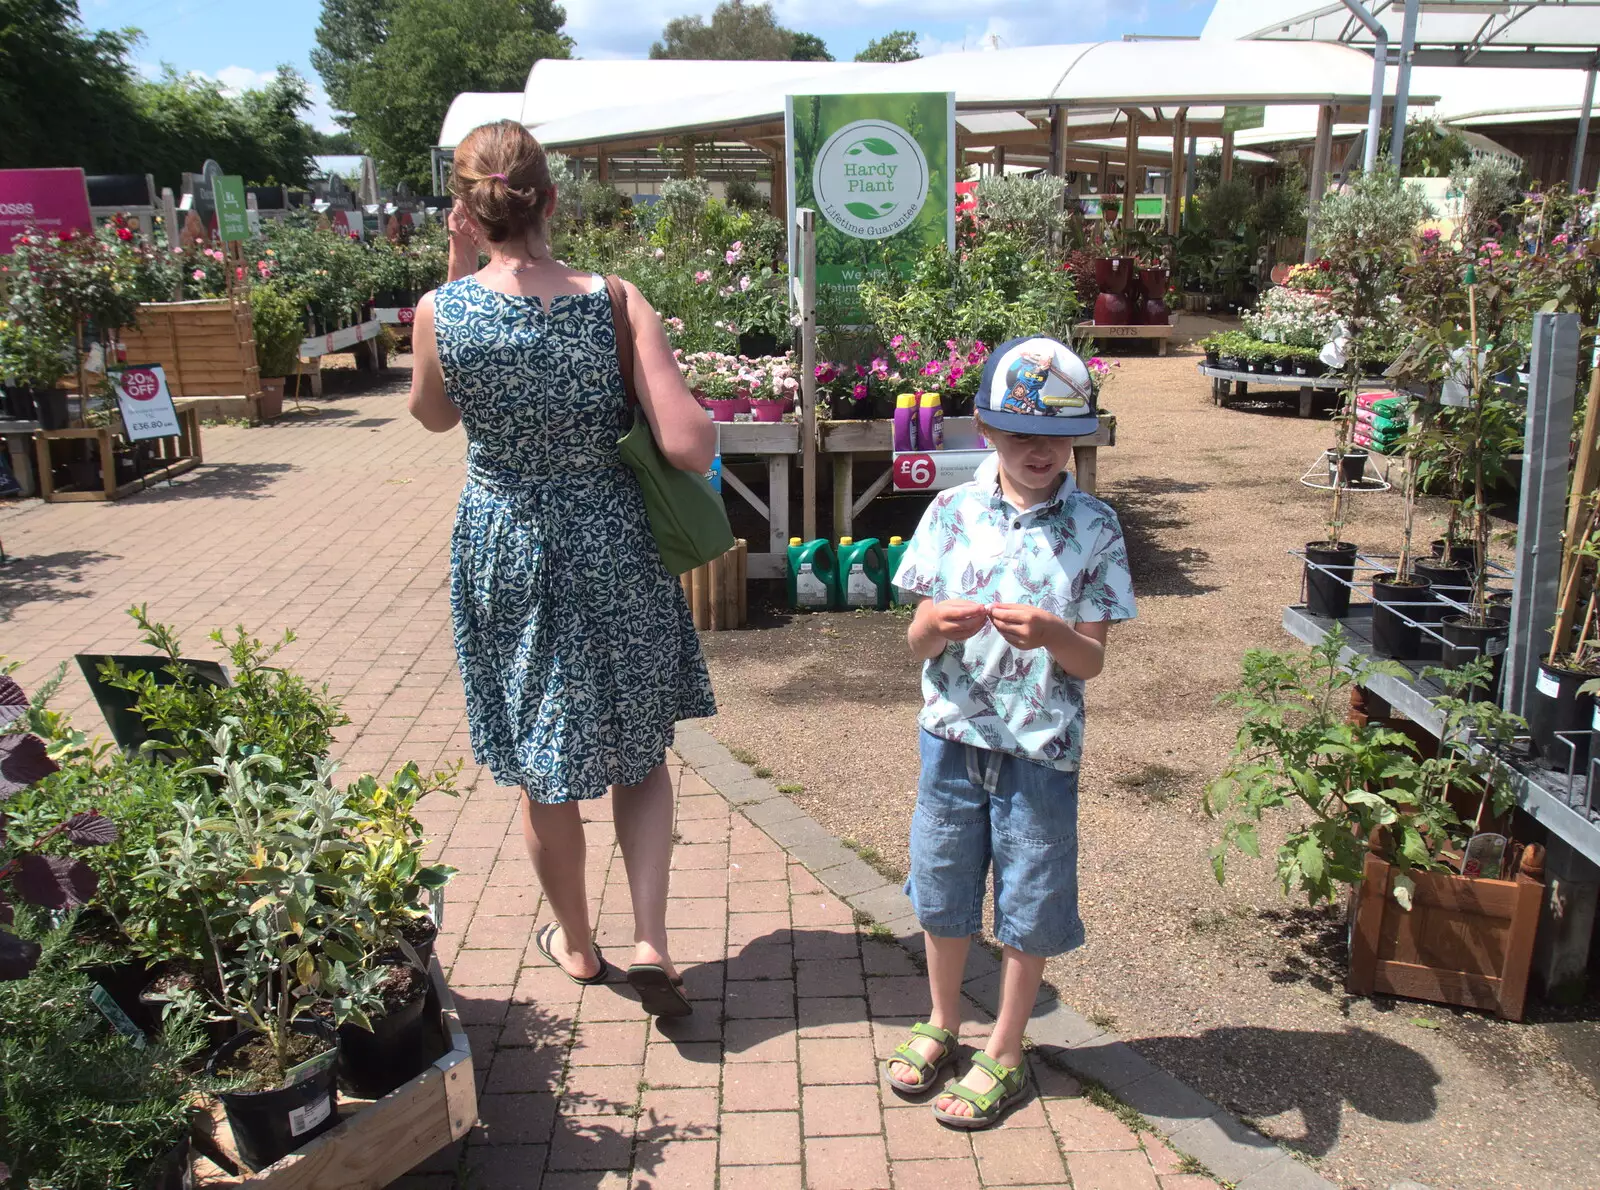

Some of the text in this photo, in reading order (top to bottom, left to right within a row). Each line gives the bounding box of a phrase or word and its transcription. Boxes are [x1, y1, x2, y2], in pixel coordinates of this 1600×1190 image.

[843, 163, 898, 178] Hardy
[848, 179, 895, 193] Plant
[0, 203, 34, 215] oses
[825, 203, 918, 236] Lifetime Guarantee
[842, 270, 861, 280] We
[1109, 327, 1138, 337] POTS
[127, 373, 154, 385] 20%
[128, 384, 155, 396] OFF
[901, 459, 930, 484] £6
